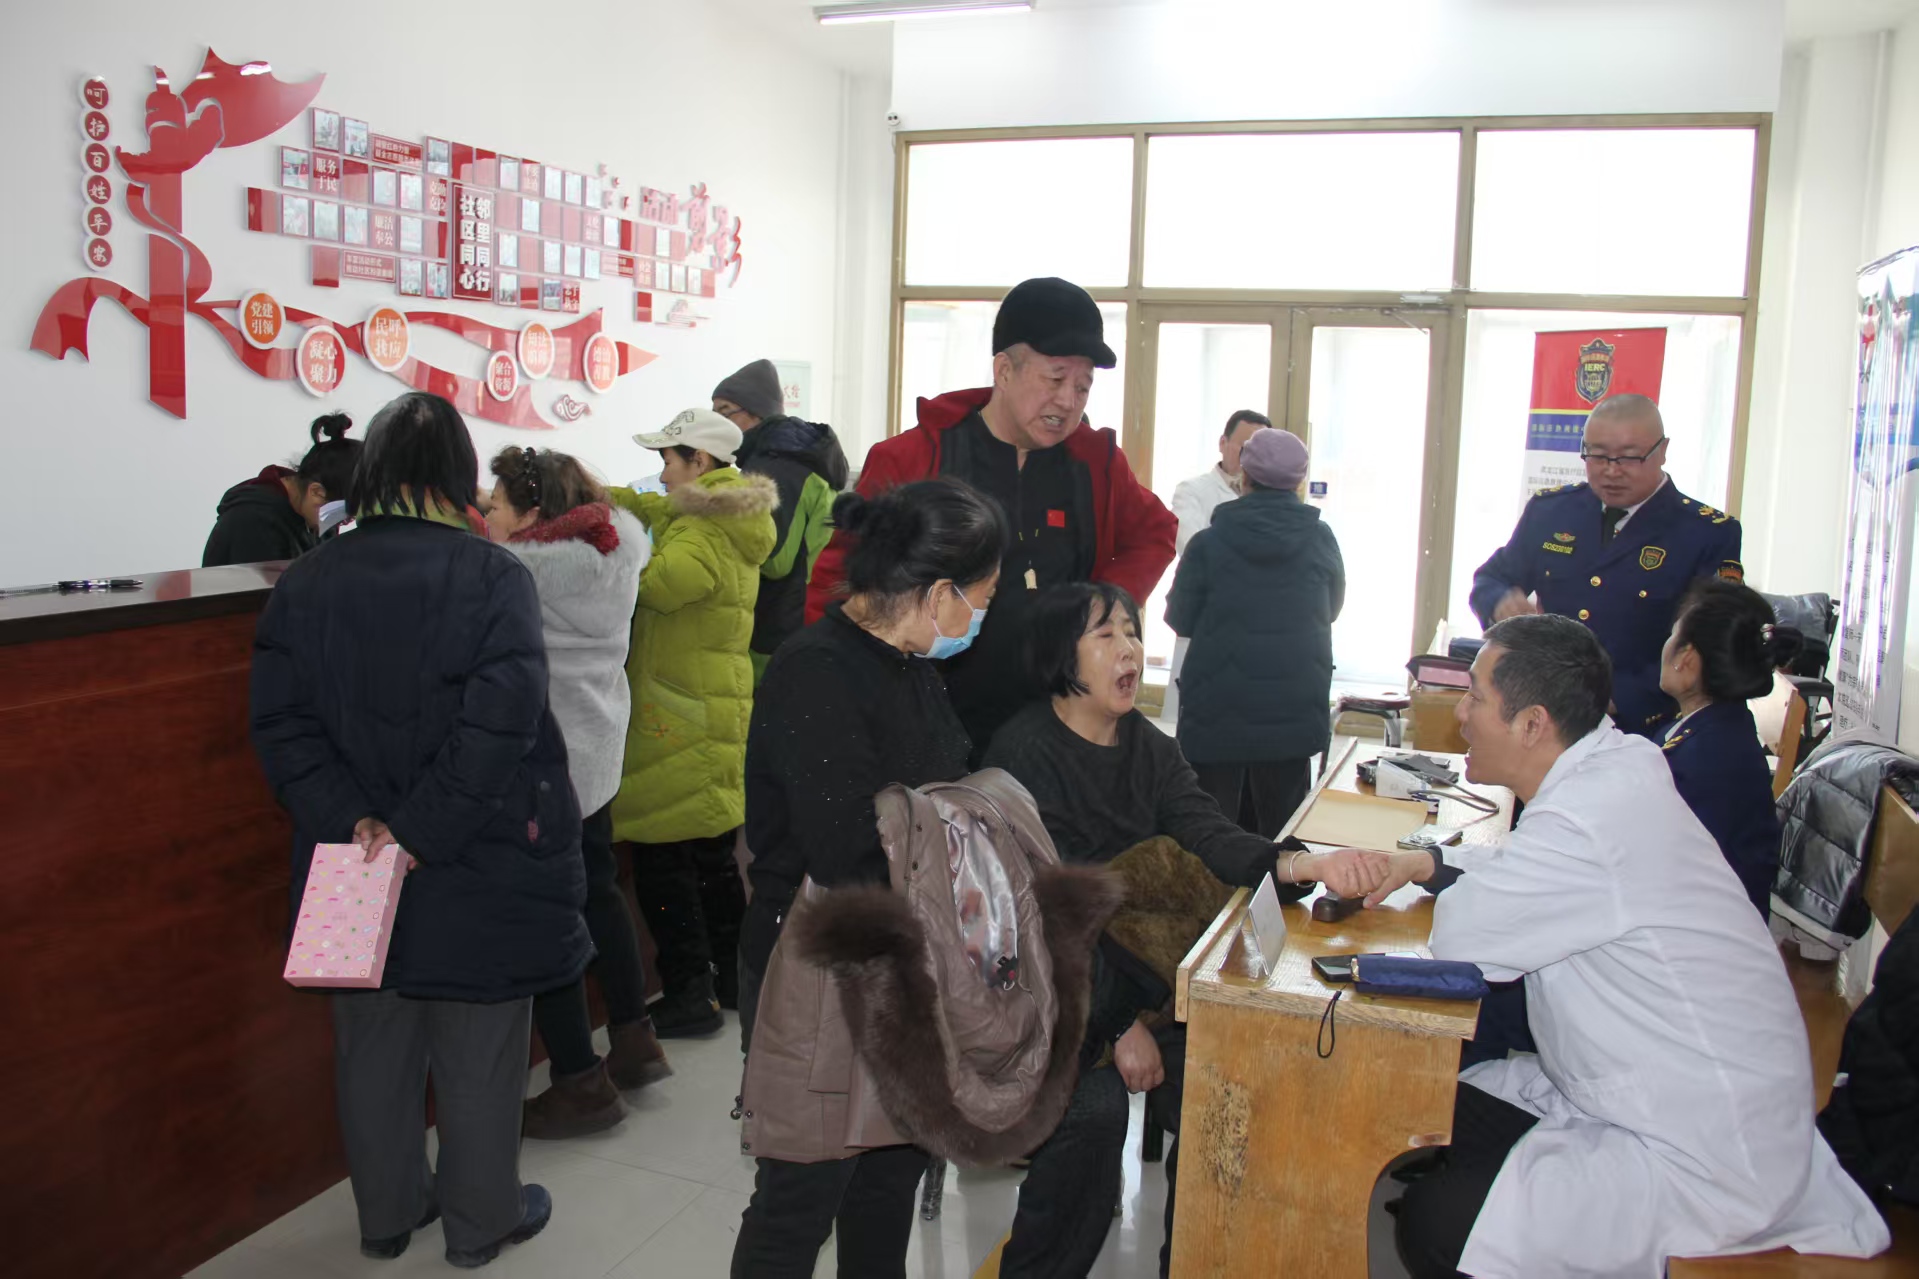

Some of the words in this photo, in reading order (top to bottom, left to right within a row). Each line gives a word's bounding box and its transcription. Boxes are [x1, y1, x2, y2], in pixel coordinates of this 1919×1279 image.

[316, 157, 337, 175] 服务
[319, 175, 338, 192] 于民
[375, 215, 394, 231] 廉洁
[375, 231, 393, 246] 奉公
[251, 302, 274, 318] 党建
[252, 319, 274, 335] 引领
[375, 317, 402, 337] 民呼
[310, 340, 338, 360] 凝心
[375, 338, 402, 359] 我应
[310, 363, 338, 384] 聚力
[1584, 363, 1606, 372] IERC
